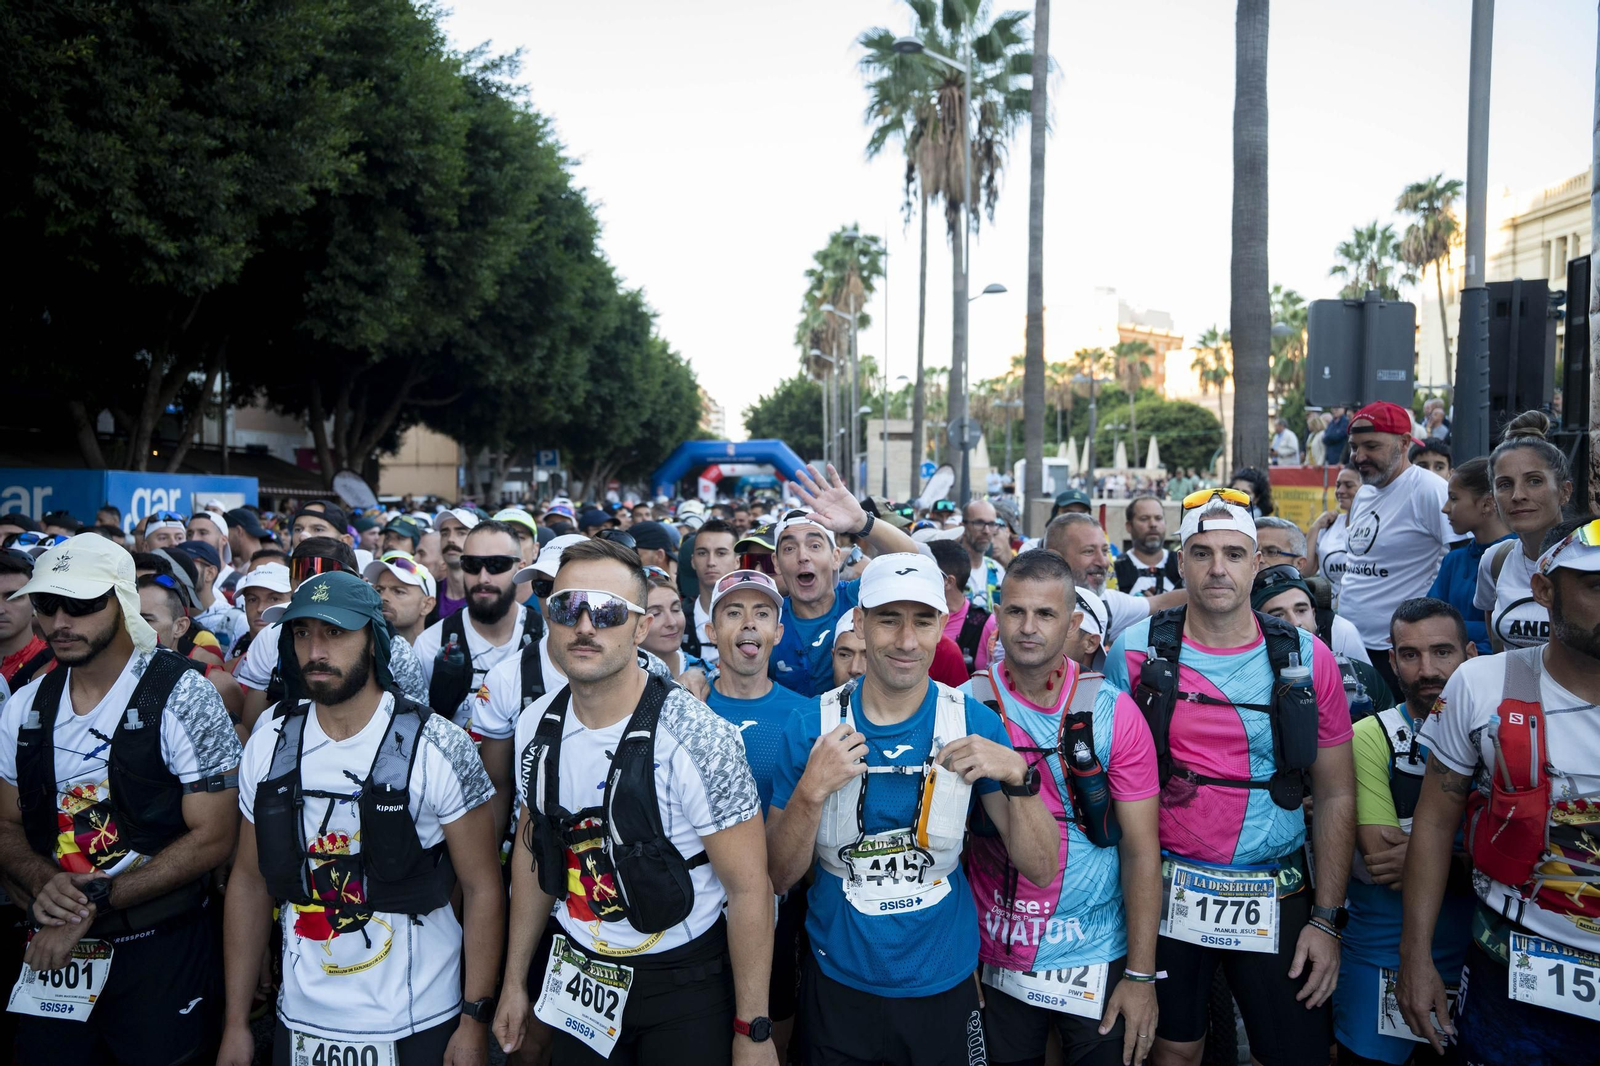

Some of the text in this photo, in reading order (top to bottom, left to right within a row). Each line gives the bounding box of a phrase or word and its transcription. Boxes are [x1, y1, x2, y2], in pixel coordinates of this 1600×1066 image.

[1353, 527, 1370, 538] AND
[376, 803, 404, 812] KIPRUN
[1196, 896, 1261, 925] 1776
[985, 911, 1085, 946] VIATOR
[1540, 942, 1560, 954] LA
[38, 961, 93, 990] 4601
[1548, 963, 1600, 1005] 15
[565, 971, 620, 1022] 4602
[312, 1043, 378, 1066] 4600
